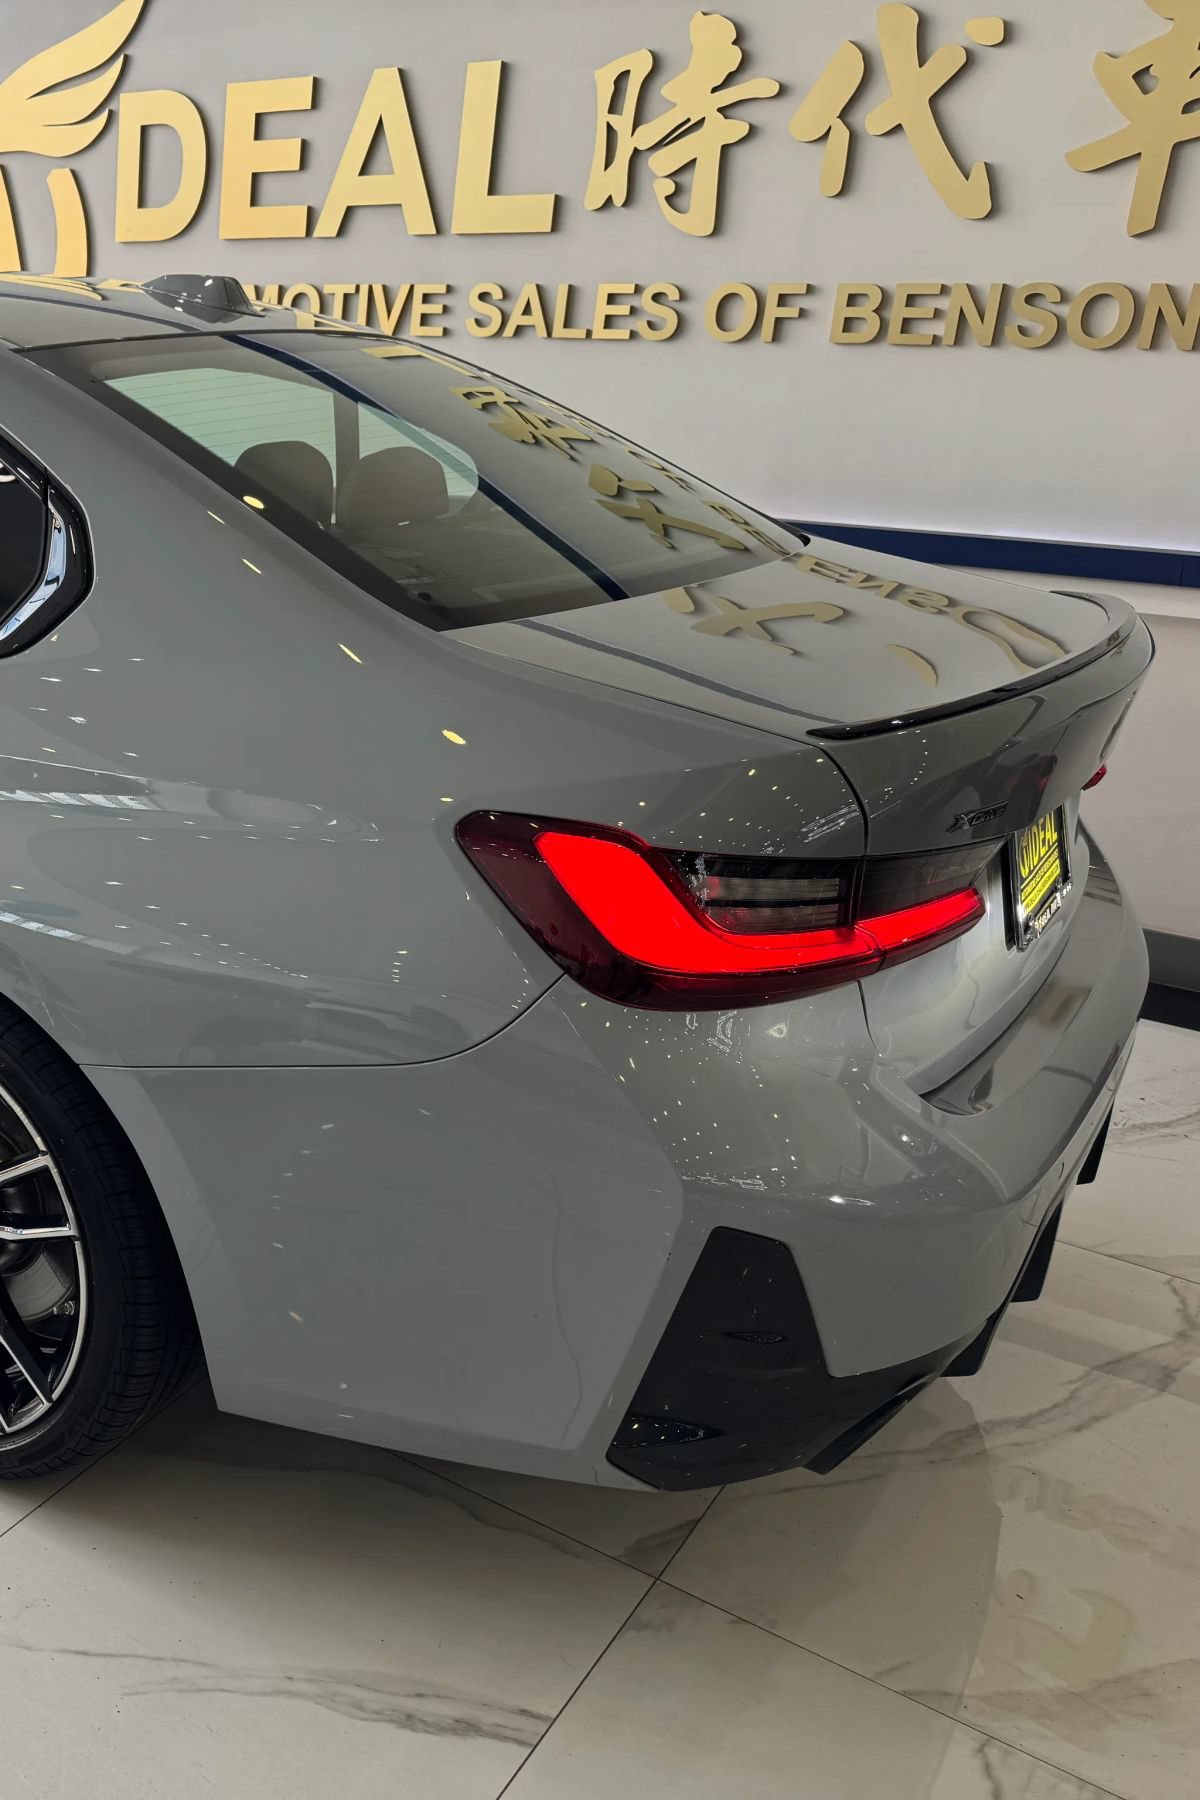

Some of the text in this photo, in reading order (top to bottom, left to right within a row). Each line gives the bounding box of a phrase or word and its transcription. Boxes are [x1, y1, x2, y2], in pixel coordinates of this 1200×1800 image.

[465, 283, 681, 341] SALES
[704, 283, 808, 343] OF
[829, 282, 1200, 351] BENSON
